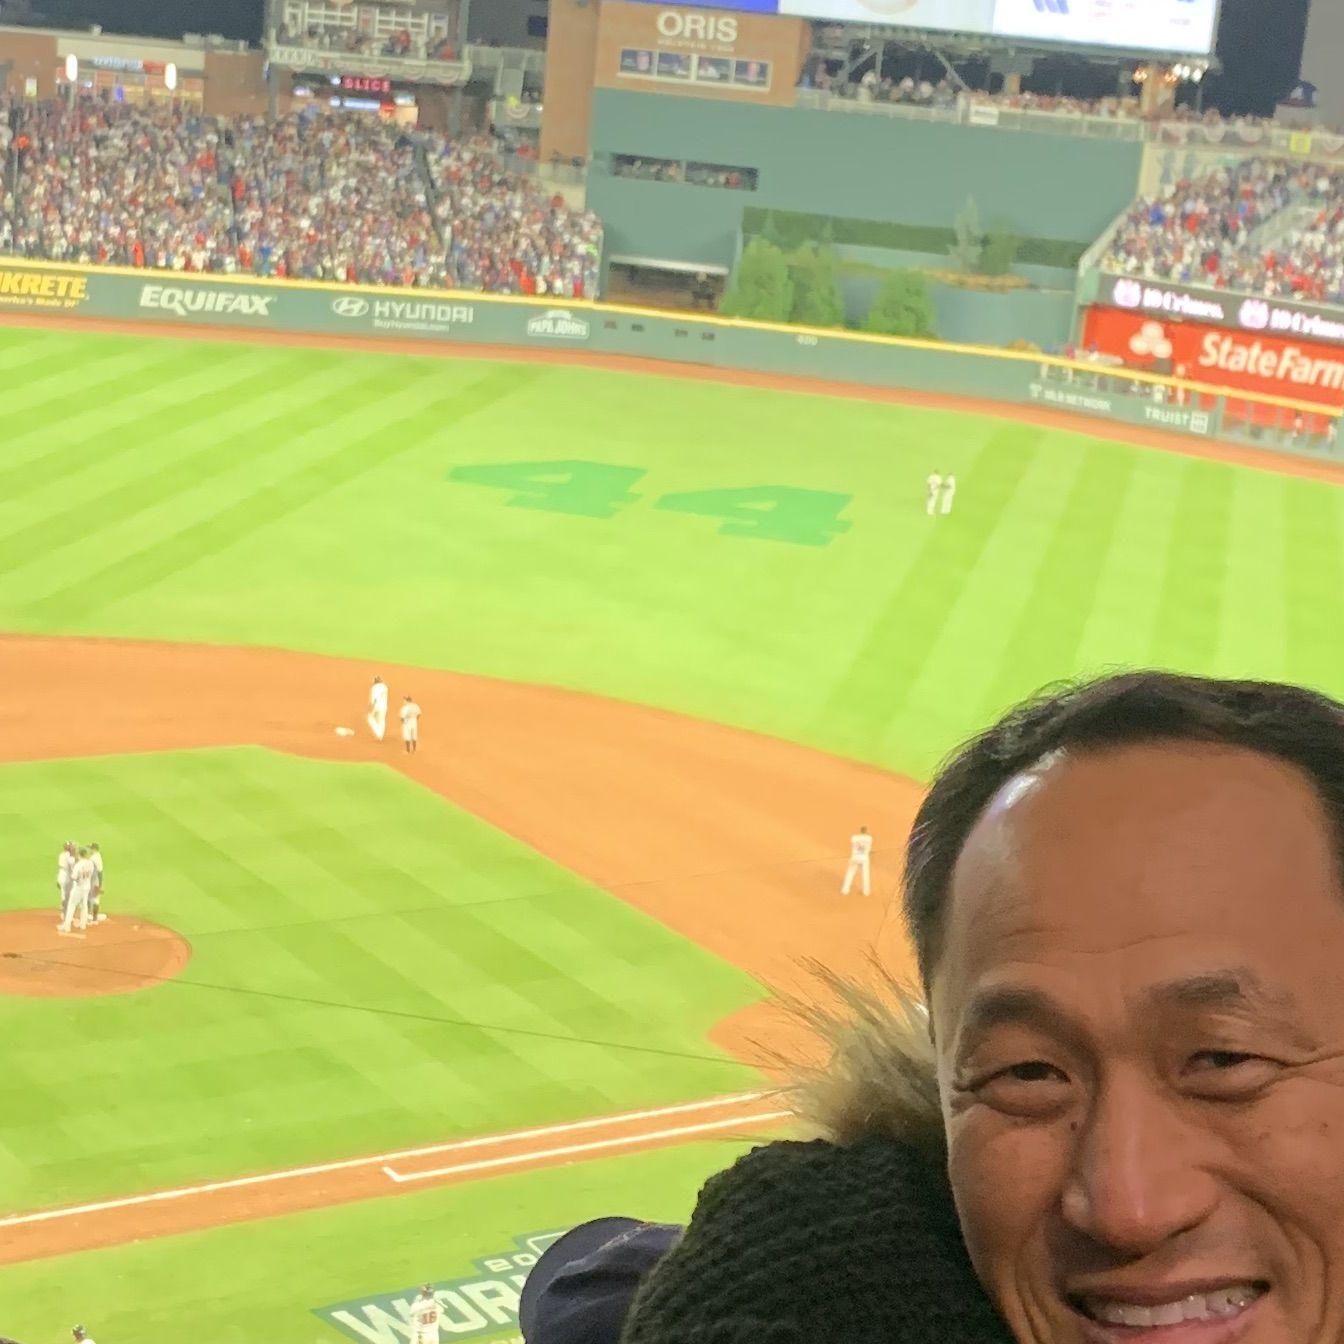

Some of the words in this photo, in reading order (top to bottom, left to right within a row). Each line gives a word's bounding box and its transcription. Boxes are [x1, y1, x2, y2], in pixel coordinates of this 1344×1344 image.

[657, 11, 738, 42] ORIS
[139, 285, 272, 316] EQUIFAX
[373, 300, 474, 324] HYUNDAI
[1144, 405, 1190, 426] TRUIST
